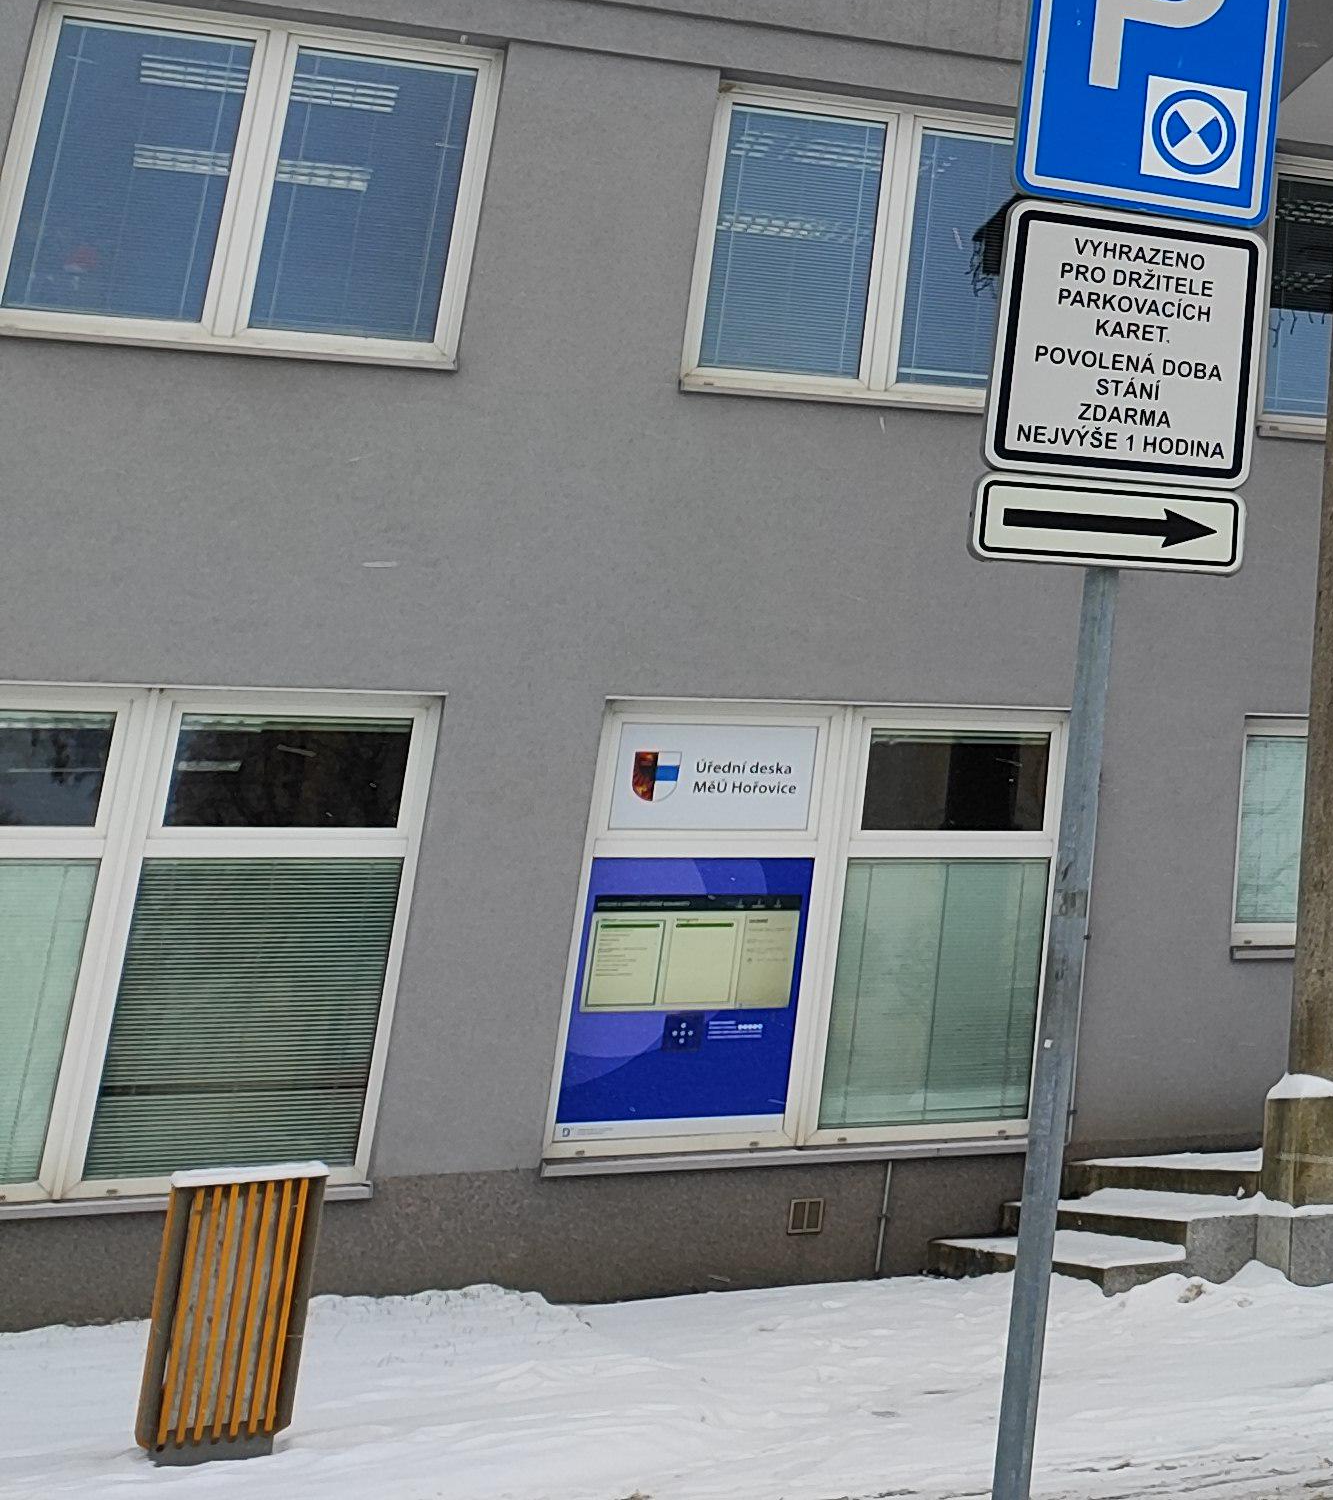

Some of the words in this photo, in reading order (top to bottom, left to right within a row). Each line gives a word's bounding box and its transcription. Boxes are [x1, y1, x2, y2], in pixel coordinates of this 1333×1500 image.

[1074, 237, 1206, 271] VYHRAZENO
[1060, 262, 1106, 284] PRO
[1112, 268, 1214, 298] DRŽITELE
[1057, 288, 1211, 323] PARKOVACÍCH
[1095, 318, 1170, 344] KARET.
[1034, 345, 1155, 375] POVOLENÁ
[1162, 359, 1223, 382] DOBA
[1095, 377, 1161, 401] STÁNÍ
[1077, 402, 1171, 429] ZDARMA
[1016, 424, 1118, 450] NEJVÝŠE
[1125, 434, 1135, 452] 1
[1142, 435, 1225, 460] HODINA
[696, 758, 747, 774] Úřední
[749, 761, 792, 775] deska
[692, 778, 728, 794] MěÚ
[731, 780, 797, 795] Hořovice
